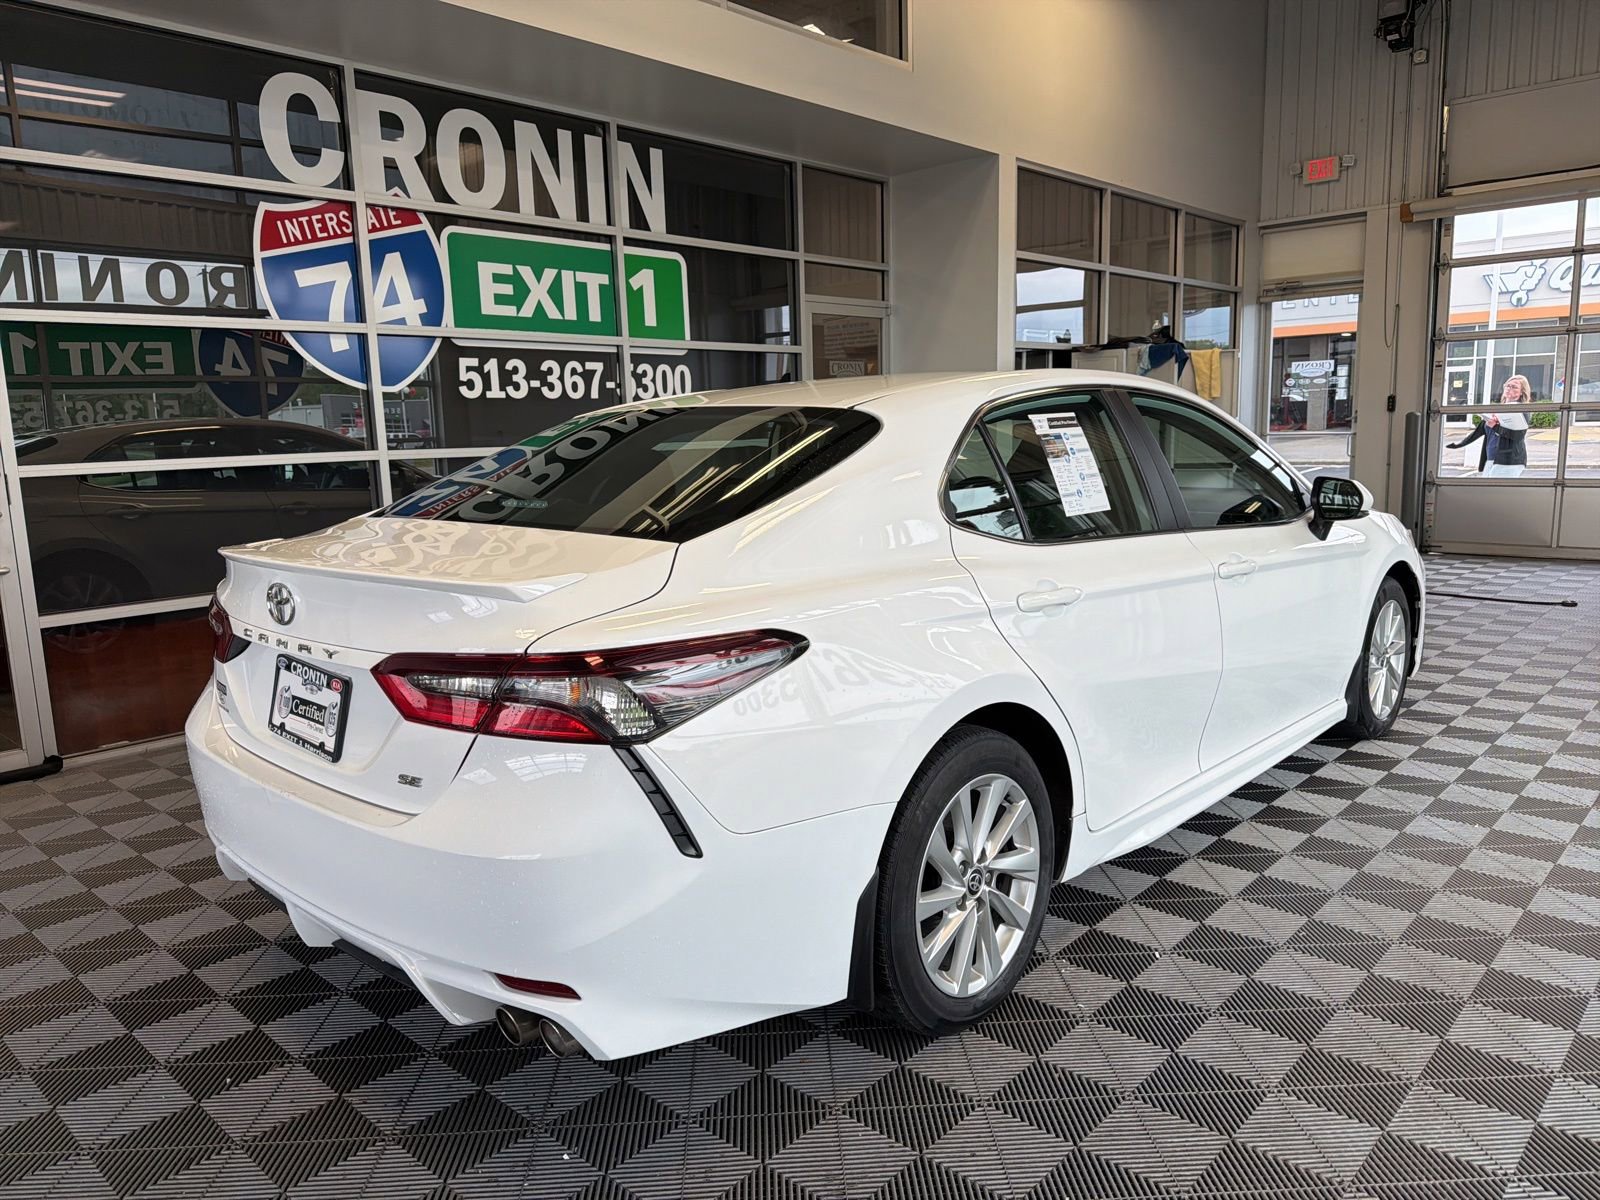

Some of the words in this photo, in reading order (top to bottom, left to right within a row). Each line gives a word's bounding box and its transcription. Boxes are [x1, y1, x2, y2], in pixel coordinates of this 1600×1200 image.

[258, 72, 667, 235] CRONIN
[1308, 156, 1335, 180] EXIT
[276, 205, 402, 244] INTERSATE
[294, 251, 427, 353] 74
[477, 261, 609, 322] EXIT
[628, 268, 657, 327] 1
[243, 628, 340, 660] CAMRY
[290, 661, 328, 688] CRONIN
[292, 699, 325, 722] Certified
[282, 731, 298, 744] EXIT
[304, 742, 333, 762] Harrison
[398, 773, 424, 788] SE
